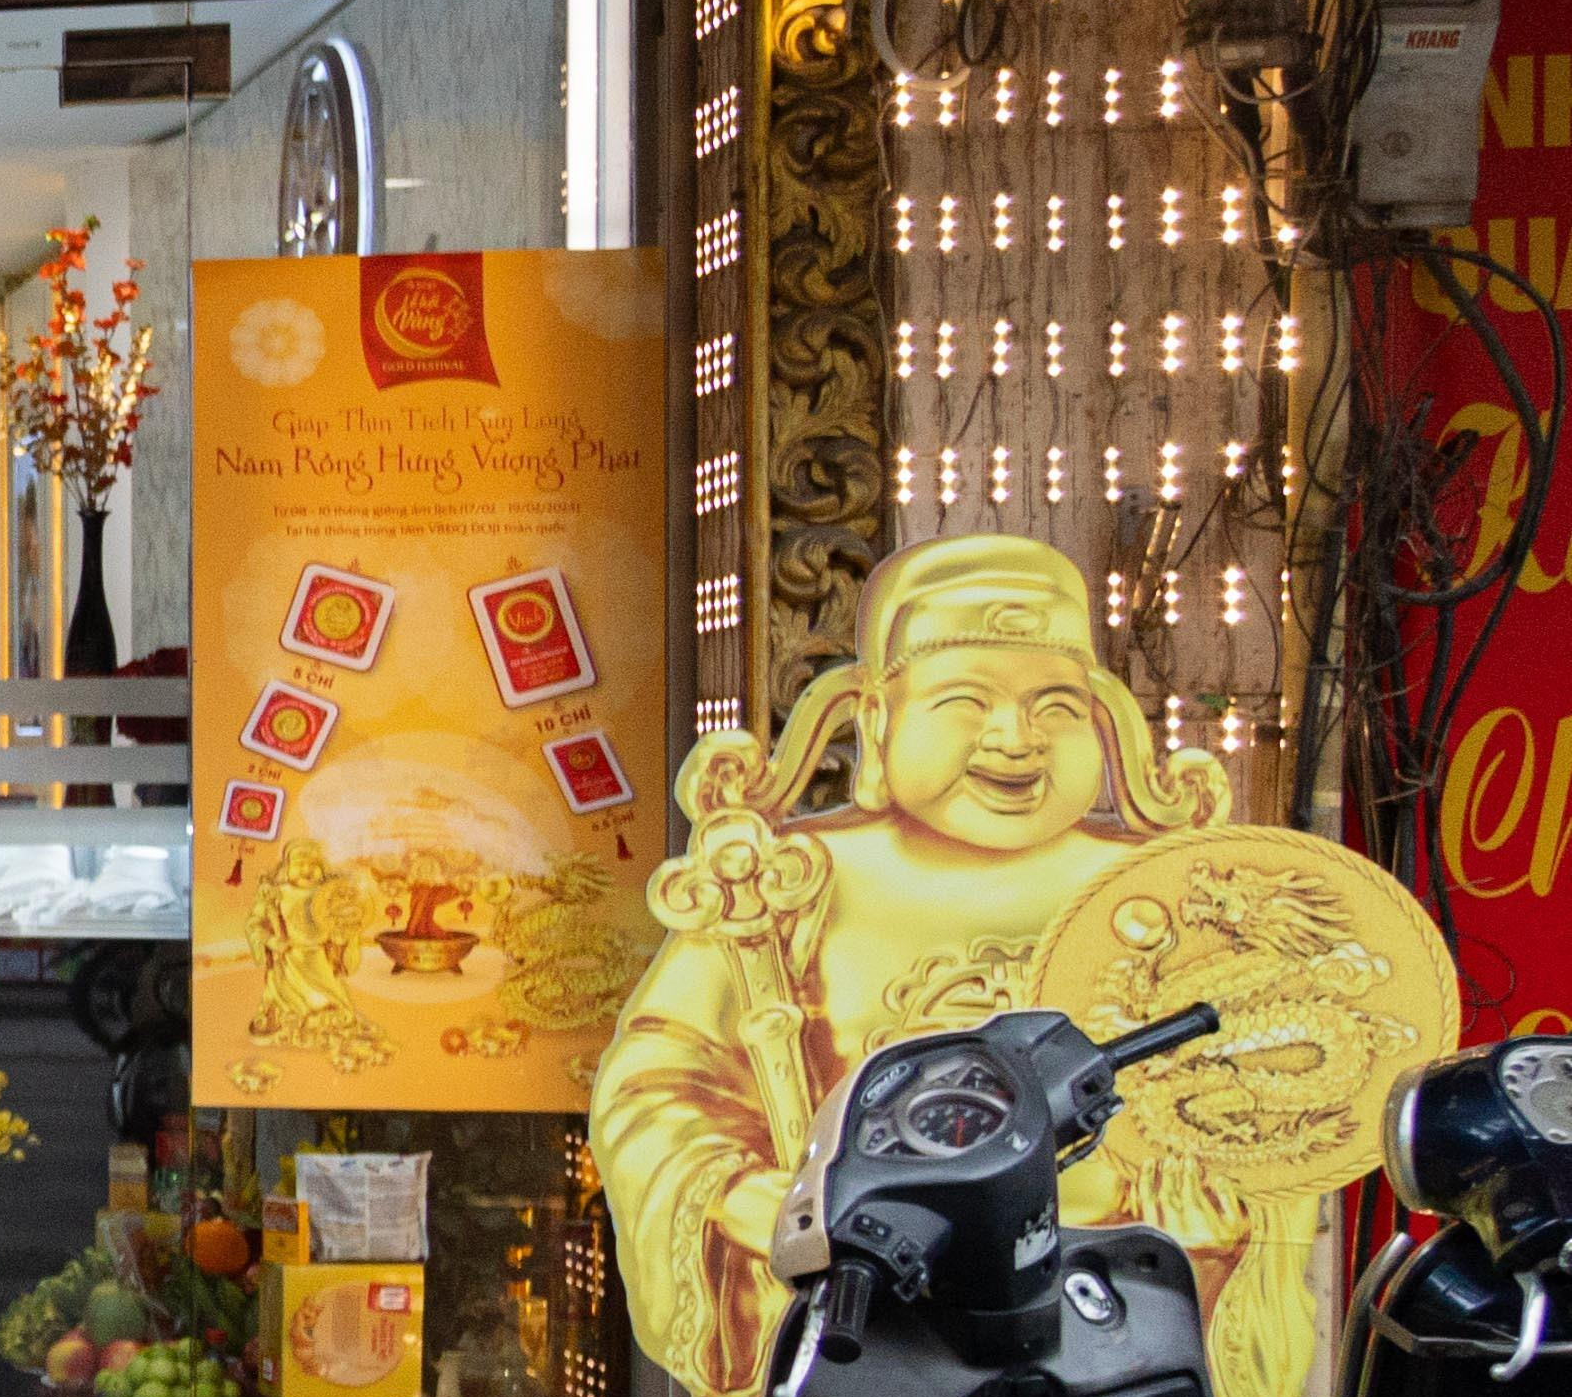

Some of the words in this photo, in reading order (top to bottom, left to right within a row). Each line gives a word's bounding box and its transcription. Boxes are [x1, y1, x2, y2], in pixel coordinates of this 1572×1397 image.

[1404, 28, 1460, 50] KHANG
[215, 444, 283, 478] Năm
[293, 446, 375, 493] Rồng
[378, 443, 464, 494] Hưng
[471, 439, 566, 493] Vượng
